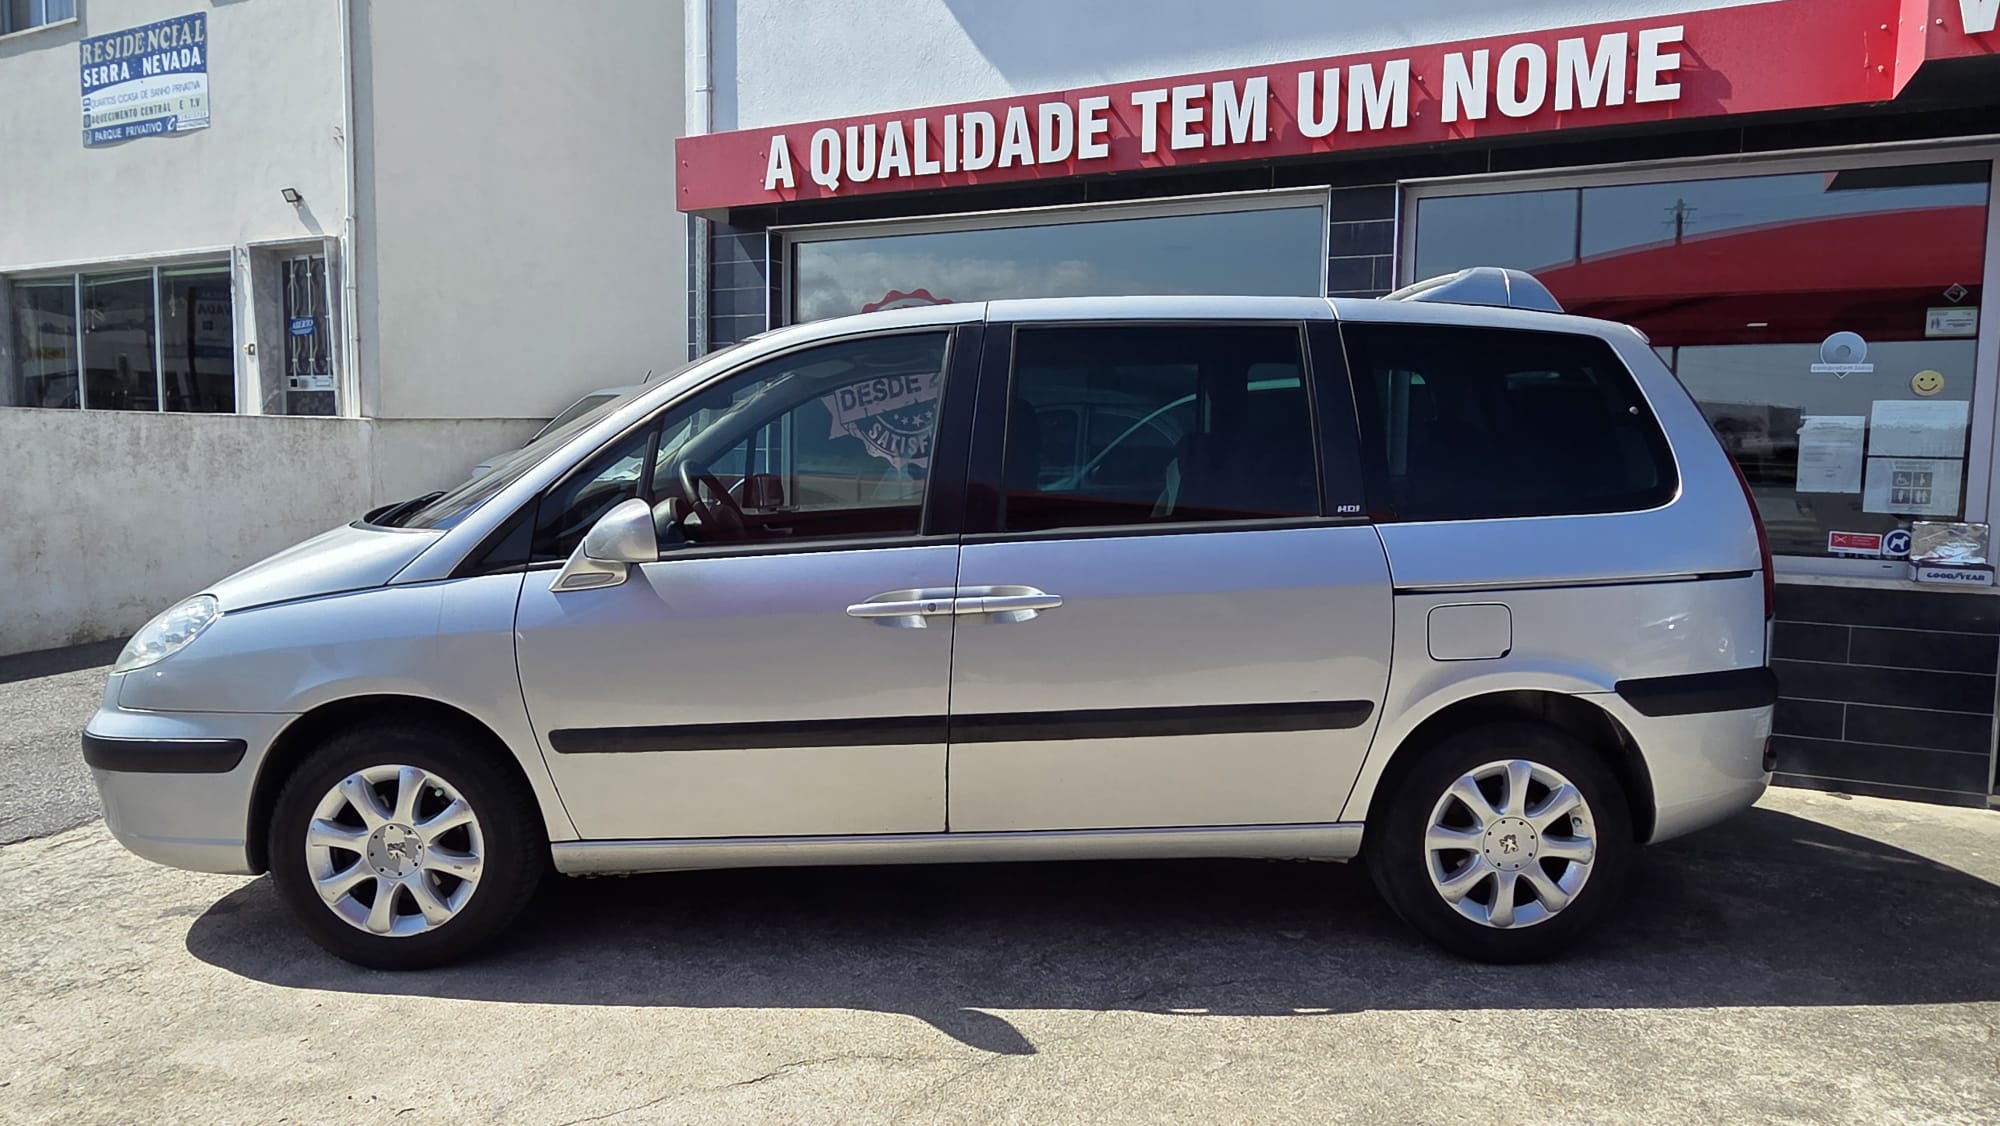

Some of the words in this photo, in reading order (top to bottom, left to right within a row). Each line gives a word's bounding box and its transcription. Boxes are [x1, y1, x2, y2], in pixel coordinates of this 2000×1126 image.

[82, 20, 205, 65] RESIDENCIAL
[83, 62, 130, 88] SERRA
[142, 46, 202, 76] NEVADA
[140, 89, 149, 99] DE
[763, 134, 796, 191] A
[810, 95, 1110, 192] QUALIDADE
[1131, 76, 1269, 154] TEM
[1298, 58, 1411, 138] UM
[1440, 25, 1685, 123] NOME
[91, 108, 138, 125] AQUECIMENTO
[140, 102, 171, 117] CENTRAL
[95, 129, 122, 141] PARQUE
[125, 121, 162, 136] PRIVATIVO
[839, 376, 922, 411] DESDE
